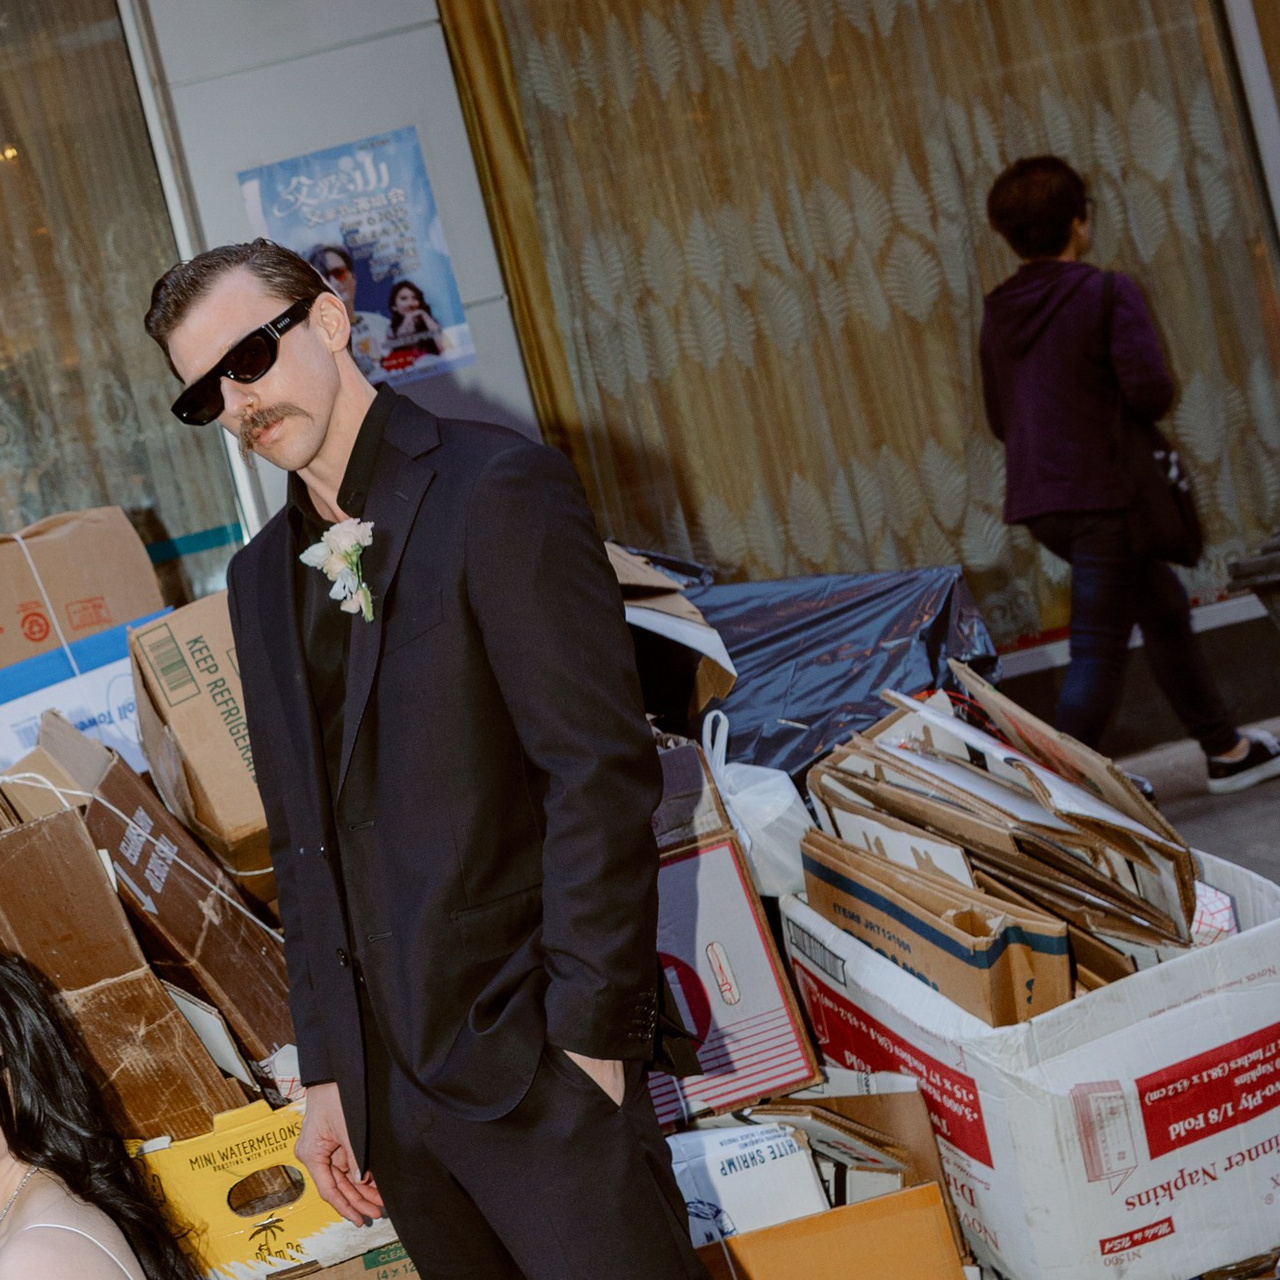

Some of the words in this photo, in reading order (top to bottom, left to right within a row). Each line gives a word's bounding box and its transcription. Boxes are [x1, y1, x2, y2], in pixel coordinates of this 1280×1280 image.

[185, 634, 220, 676] KEEP
[78, 709, 115, 731] Towe
[1229, 1047, 1264, 1070] Inches
[1264, 1042, 1276, 1057] 17
[1191, 1073, 1201, 1085] x
[1201, 1061, 1229, 1083] (38.1
[1233, 1061, 1274, 1087] Napkins
[1144, 1087, 1167, 1106] cm)
[1167, 1078, 1190, 1096] 43.2
[1207, 1101, 1235, 1125] 1/8
[1168, 1112, 1206, 1140] Fold
[188, 1151, 217, 1172] MINI
[218, 1121, 302, 1163] WATERMELONS
[246, 1151, 262, 1162] WITH
[263, 1143, 288, 1157] FLAVOR
[719, 1145, 769, 1178] SHRIMP
[1124, 1163, 1218, 1211] Napkins
[1146, 1219, 1173, 1239] Made
[1104, 1232, 1133, 1254] USA
[1103, 1249, 1142, 1268] N1500
